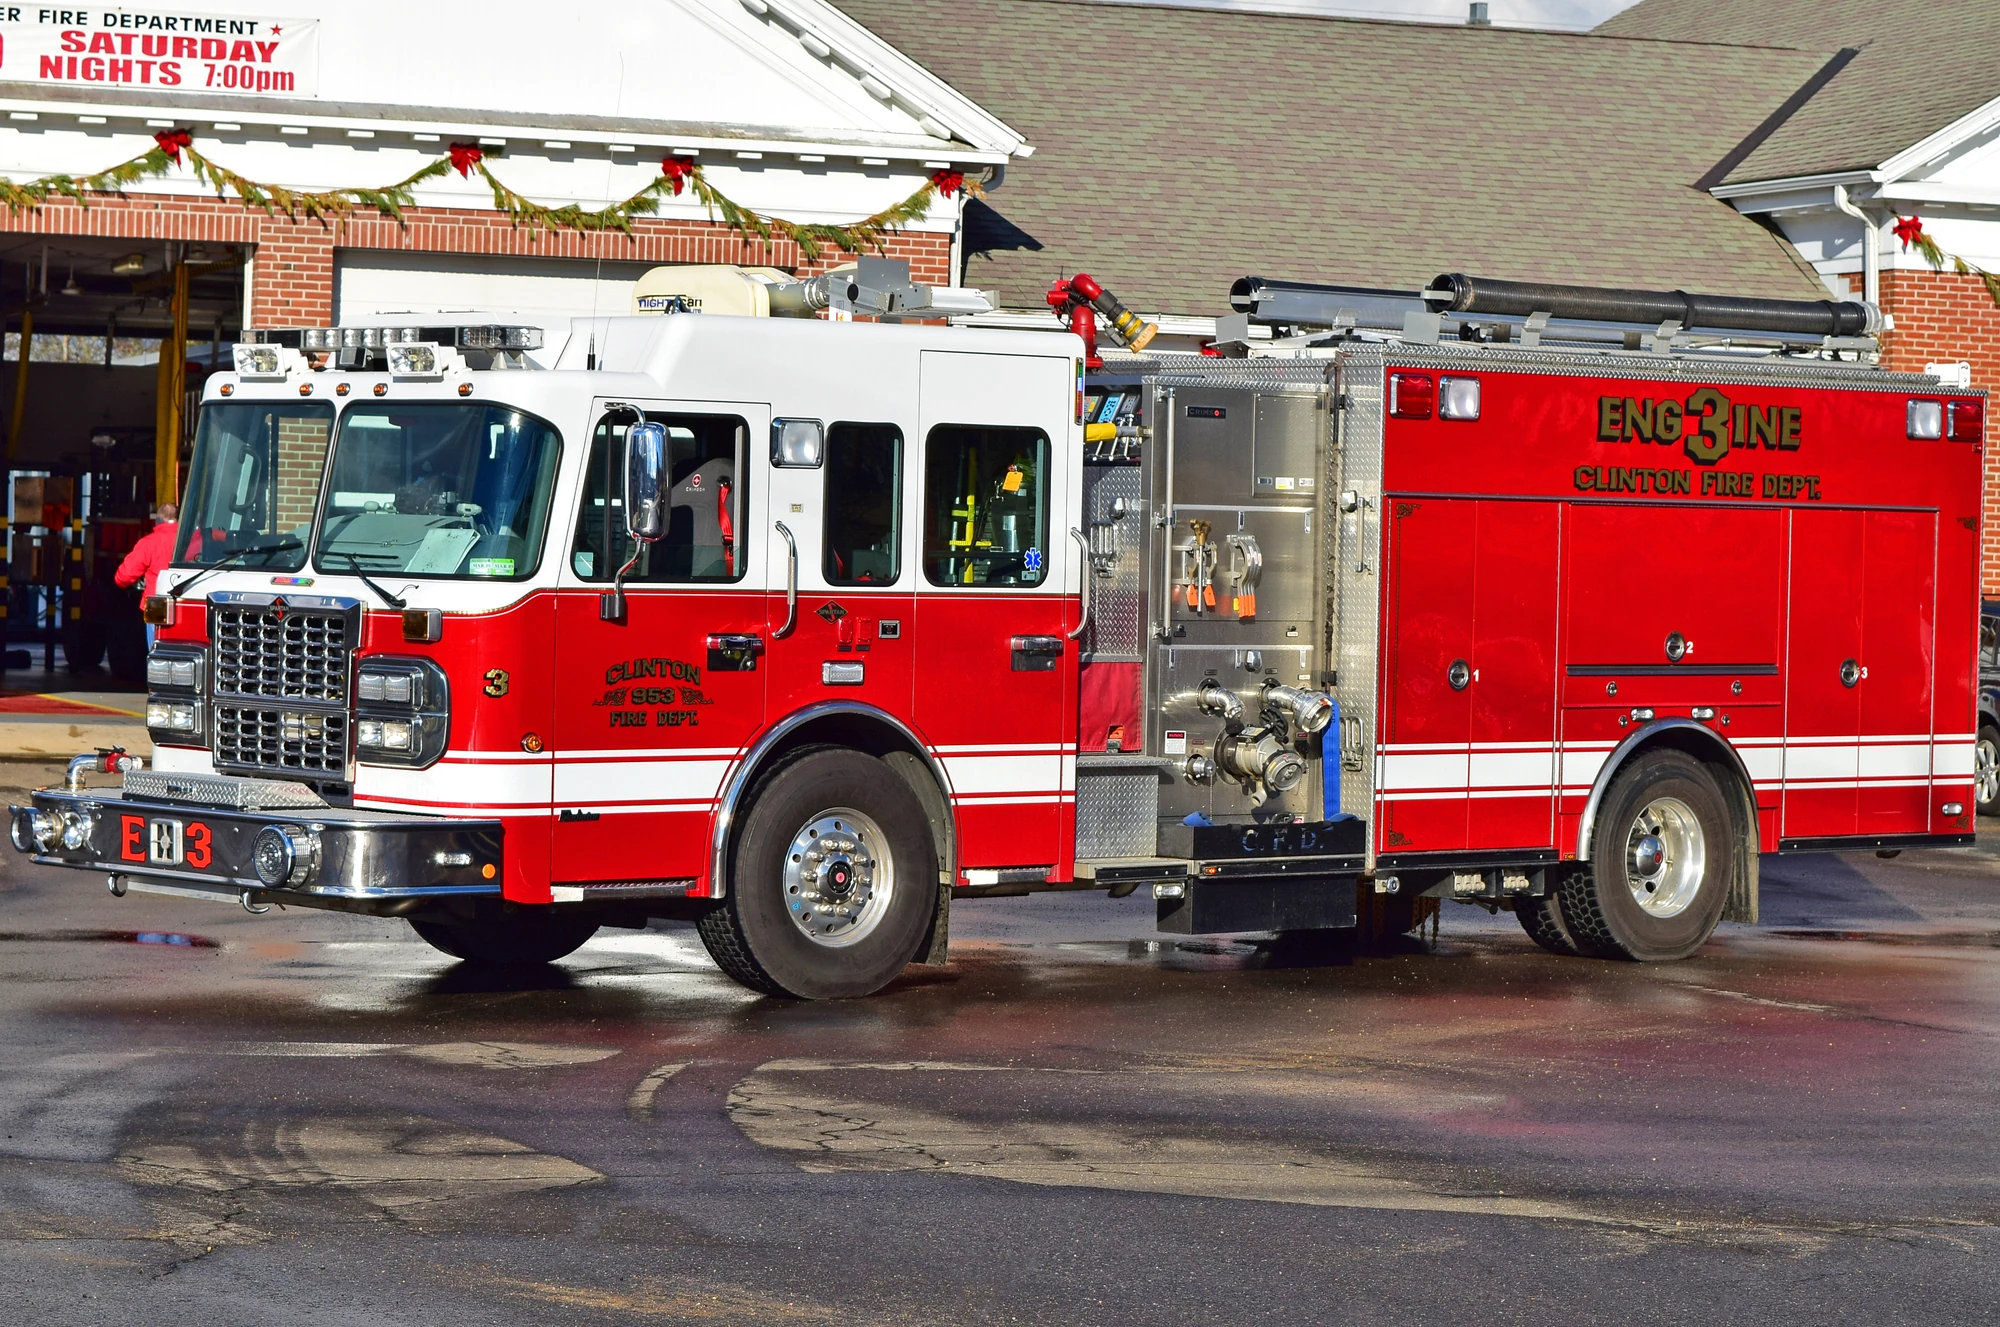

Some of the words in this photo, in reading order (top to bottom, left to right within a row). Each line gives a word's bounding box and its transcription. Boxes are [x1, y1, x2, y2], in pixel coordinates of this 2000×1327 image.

[39, 9, 88, 26] FIRE
[103, 13, 259, 35] DEPARTMENT
[60, 30, 280, 63] SATURDAY
[39, 55, 182, 86] NIGHTS
[203, 63, 295, 92] 7:00pm
[1189, 408, 1225, 416] CRIMSON
[1573, 465, 1691, 494] CLINTON
[1700, 471, 1754, 497] FIRE
[1762, 473, 1822, 500] DEPT.
[819, 608, 845, 616] SPARTAN
[1686, 641, 1694, 653] 2
[483, 668, 510, 698] 3
[606, 658, 701, 686] CLINTON
[1473, 669, 1480, 682] 1
[1860, 666, 1869, 679] 3
[631, 687, 675, 705] 953
[610, 711, 647, 727] FIRE
[657, 711, 699, 726] DEPT.
[121, 814, 146, 862] E
[186, 821, 213, 869] 3
